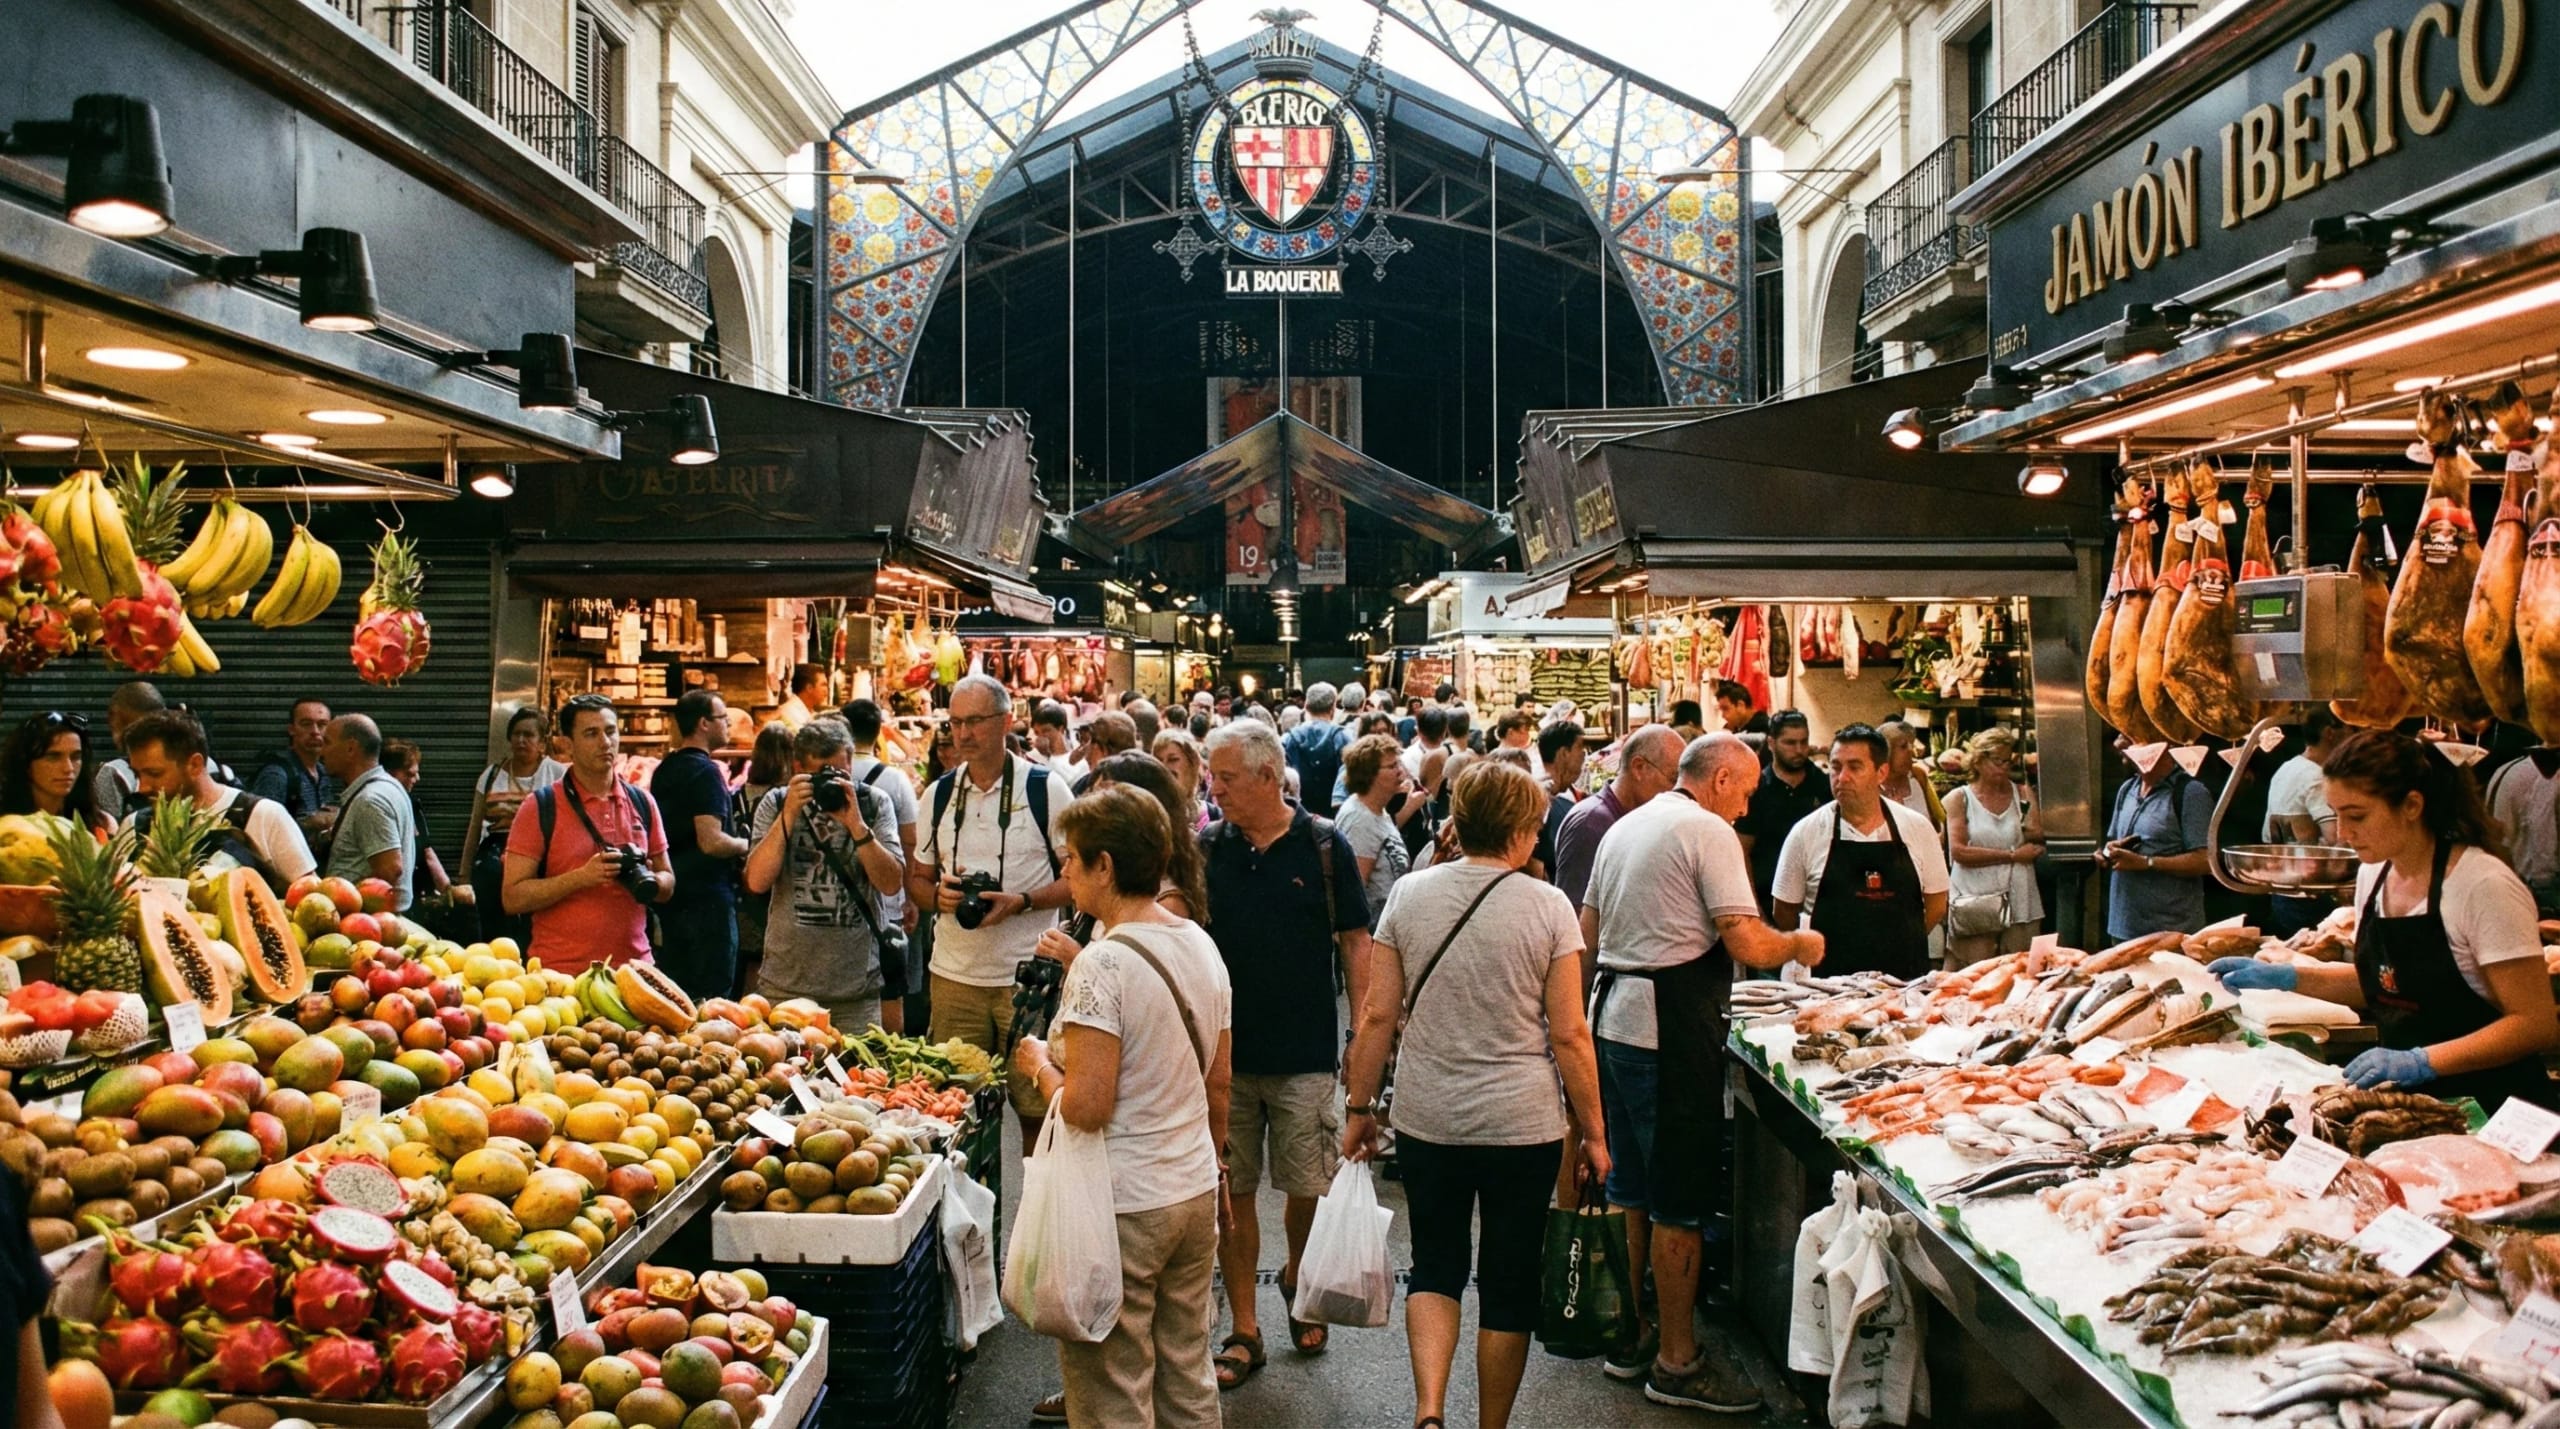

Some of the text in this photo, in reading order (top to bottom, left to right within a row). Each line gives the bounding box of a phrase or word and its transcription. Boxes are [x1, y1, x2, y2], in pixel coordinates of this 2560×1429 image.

[2044, 0, 2525, 314] JAMÓN IBÉRICO
[1226, 269, 1340, 292] LA BOQUERIA
[1239, 545, 1259, 568] 19
